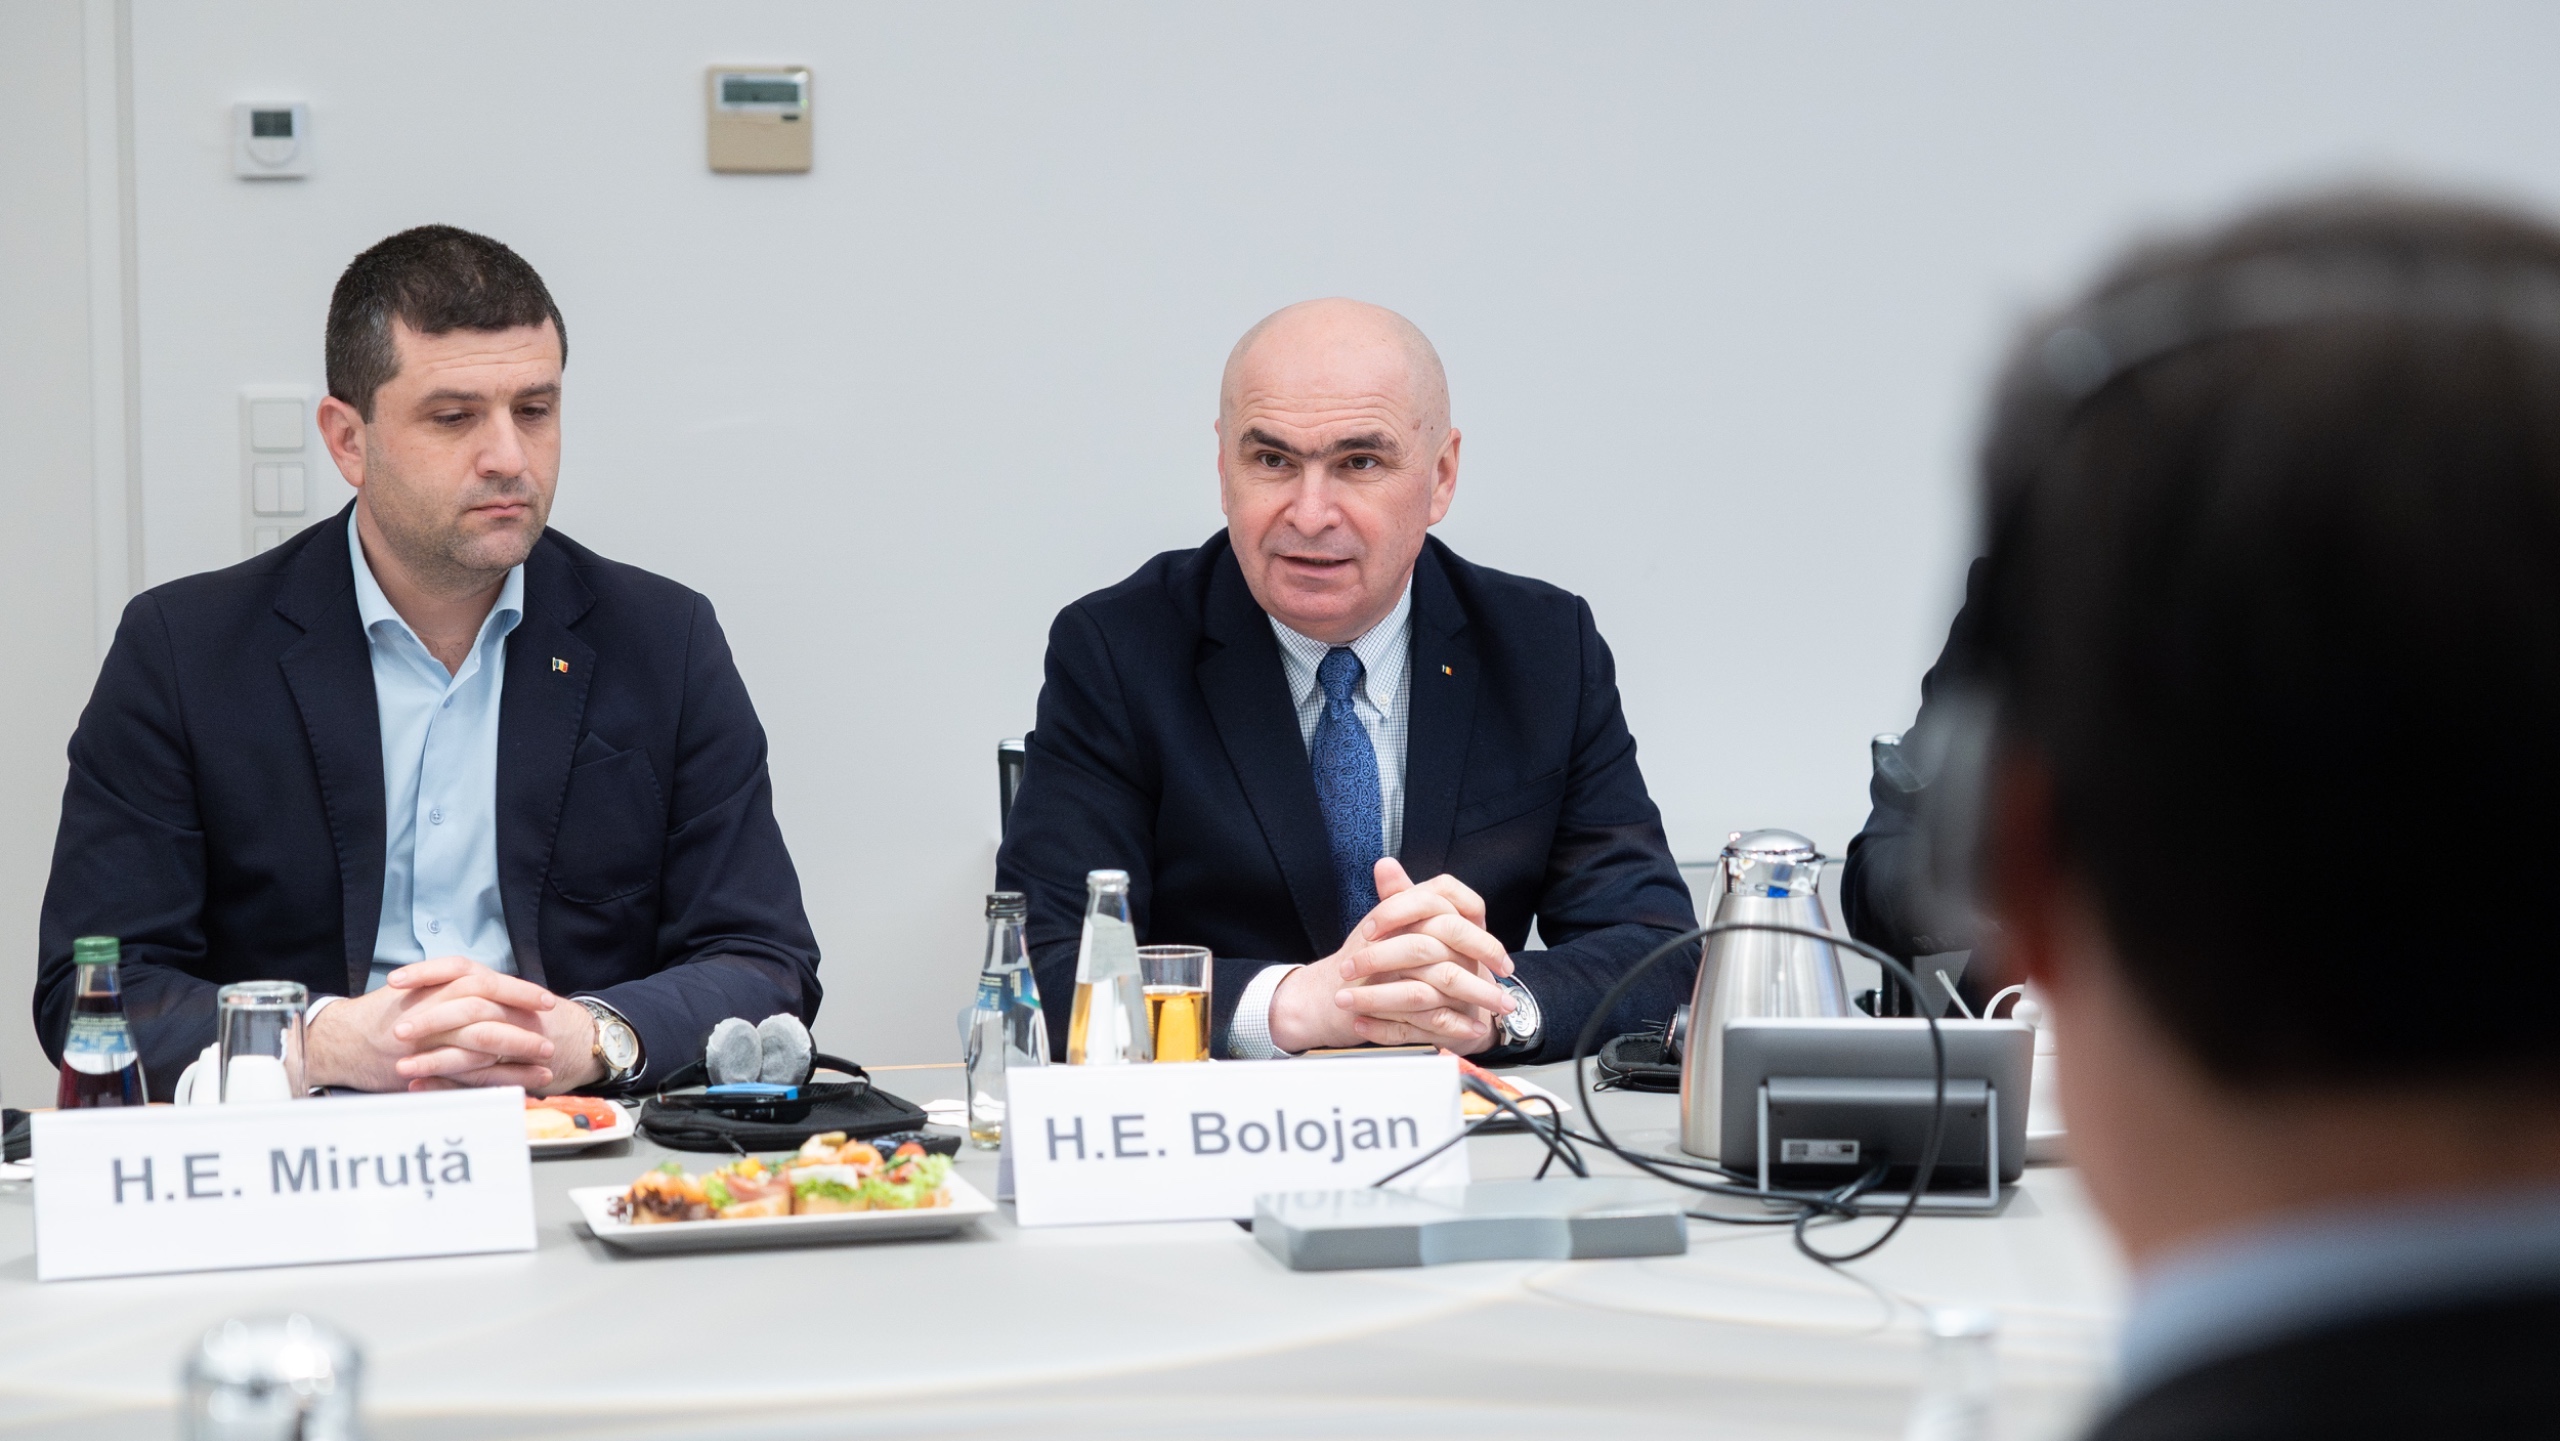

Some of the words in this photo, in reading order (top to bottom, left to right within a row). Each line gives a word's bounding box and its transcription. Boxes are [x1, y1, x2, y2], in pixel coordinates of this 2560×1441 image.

[1047, 1114, 1168, 1161] H.E.
[1190, 1106, 1419, 1164] Bolojan
[111, 1152, 243, 1204] H.E.
[269, 1137, 471, 1201] Miruță
